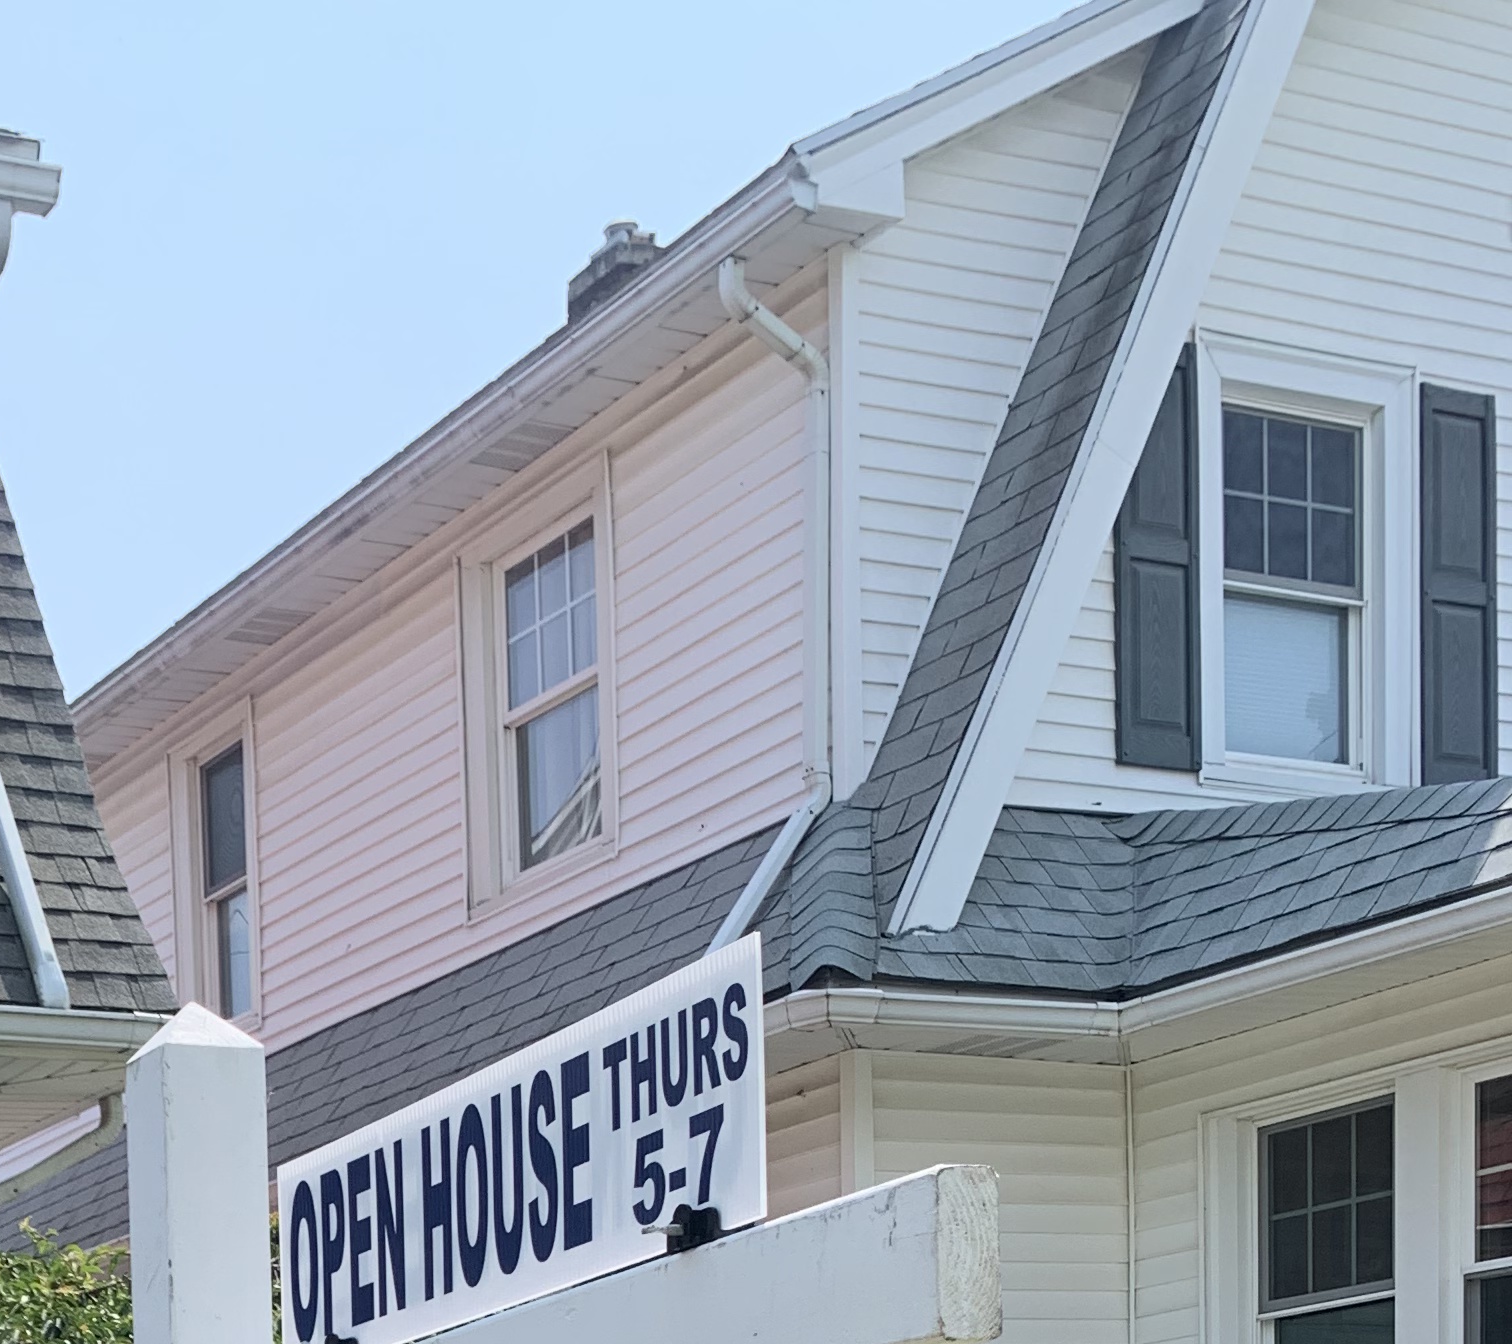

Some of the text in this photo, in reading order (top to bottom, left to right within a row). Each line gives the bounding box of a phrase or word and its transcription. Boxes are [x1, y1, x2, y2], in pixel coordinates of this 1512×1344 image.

[602, 982, 748, 1132] THURS
[290, 1051, 594, 1343] OPEN HOUSE
[632, 1103, 725, 1226] 5-7
